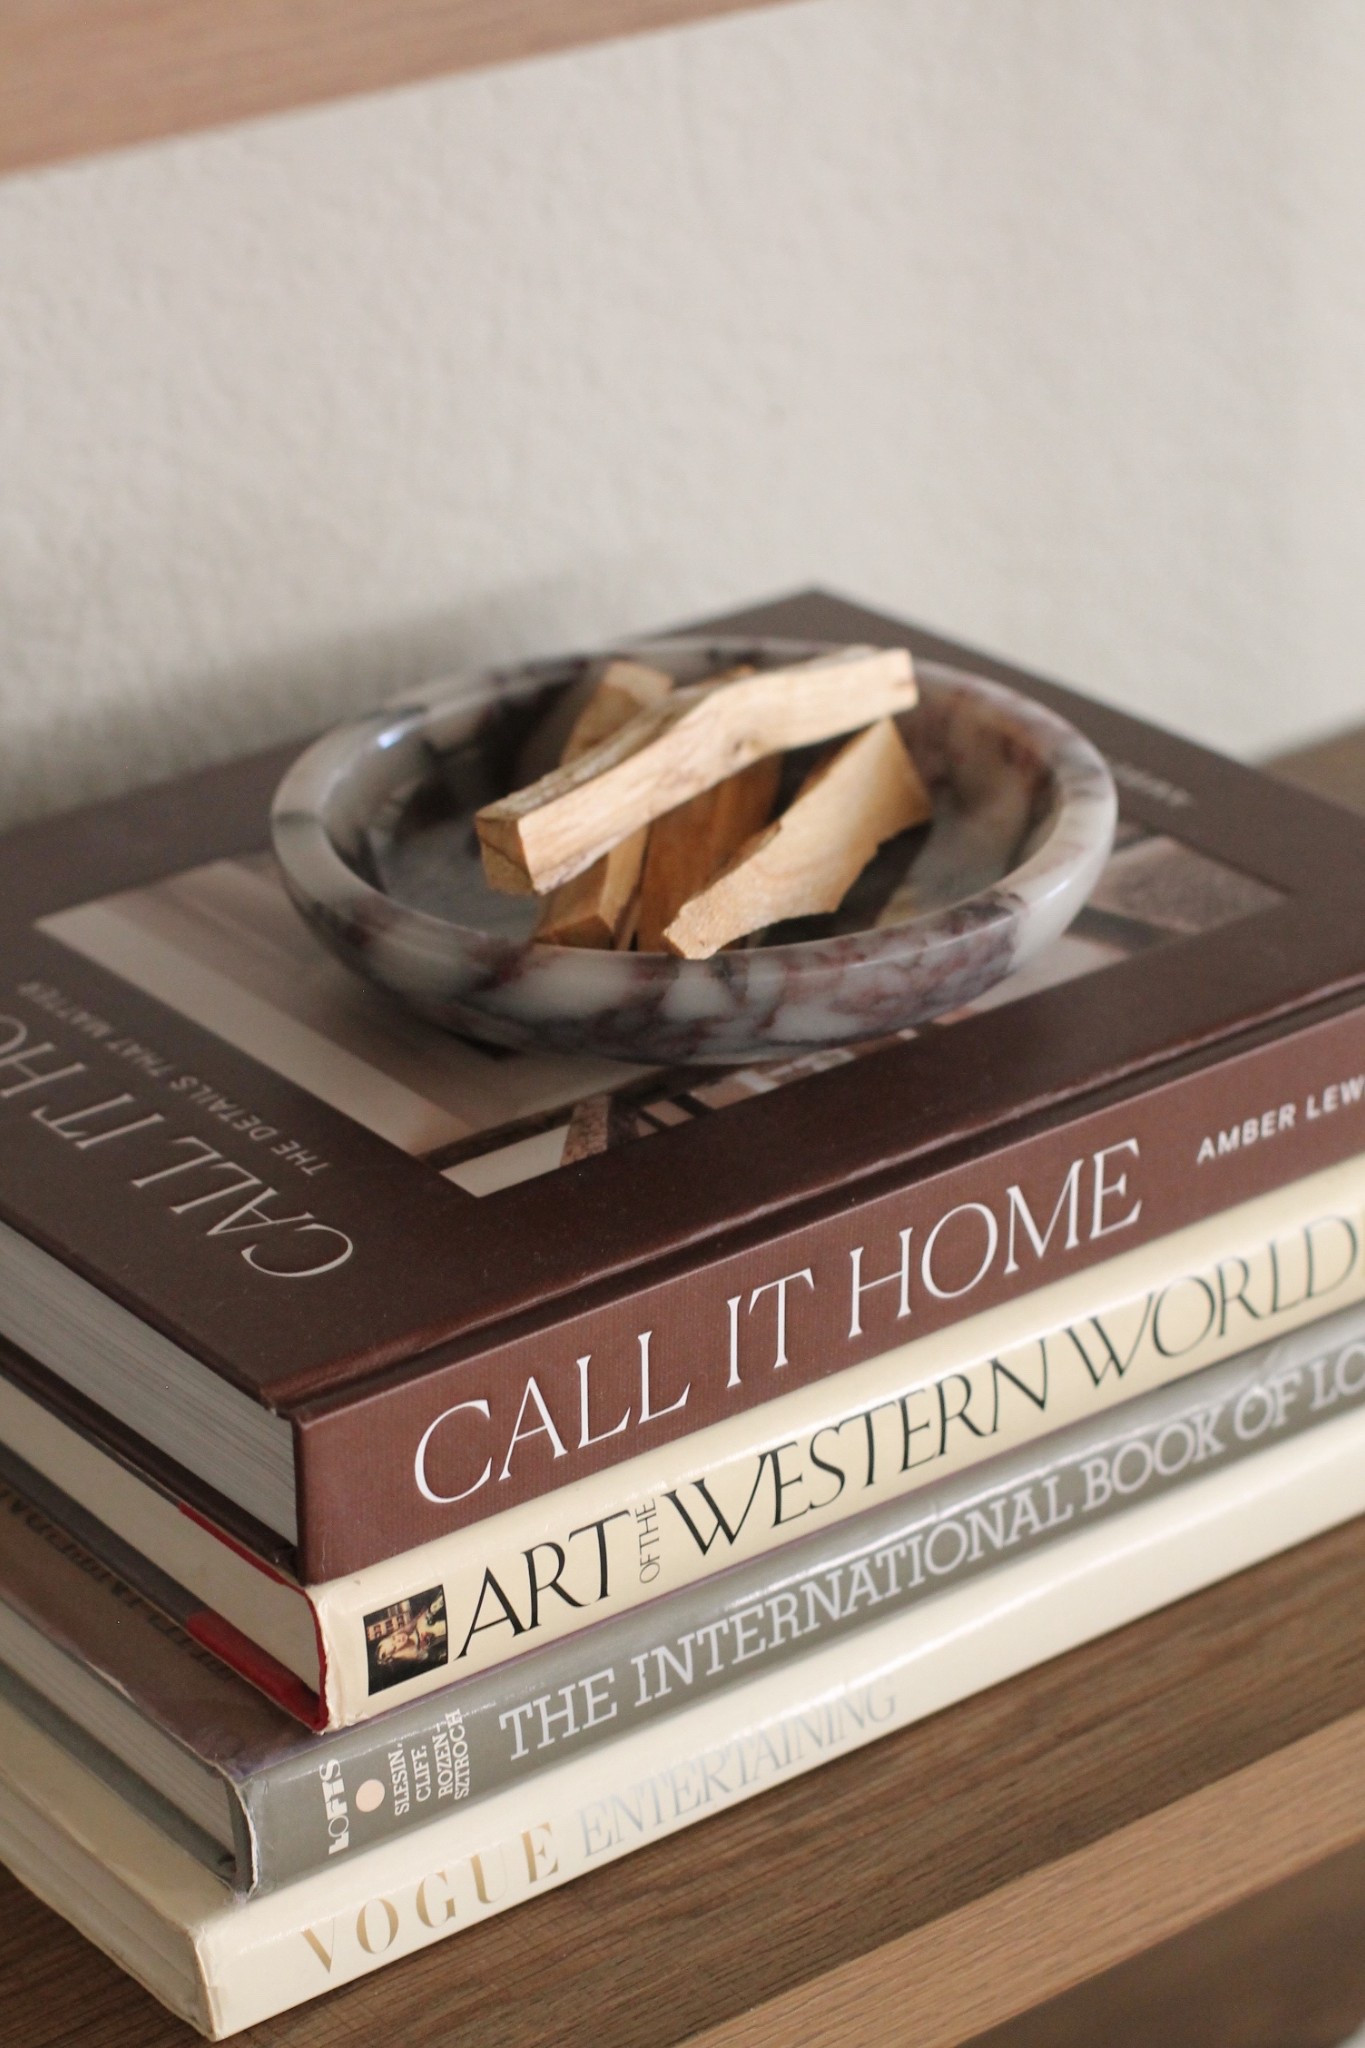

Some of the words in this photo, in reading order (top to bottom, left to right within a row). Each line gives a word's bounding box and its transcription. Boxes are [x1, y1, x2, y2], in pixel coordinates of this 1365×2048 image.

[31, 1092, 165, 1150] IT
[170, 1076, 278, 1141] DETAILS
[1197, 1103, 1297, 1165] AMBER
[270, 1140, 329, 1176] THE
[131, 1136, 353, 1278] CALL
[414, 1331, 690, 1504] CALL
[727, 1268, 814, 1389] IT
[848, 1137, 1142, 1338] HOME
[452, 1509, 631, 1662] ART
[661, 1337, 1048, 1556] WESTERN
[1064, 1214, 1358, 1387] WORLD
[499, 1667, 617, 1761] THE
[630, 1474, 1074, 1707] INTERNATIONAL
[1080, 1403, 1226, 1512] BOOK
[1234, 1370, 1302, 1441] OF
[445, 1708, 470, 1800] SZTROCH
[301, 1822, 559, 1974] VOGUE
[576, 1672, 897, 1858] ENTERTAINING
[319, 1759, 349, 1855] LOFTS
